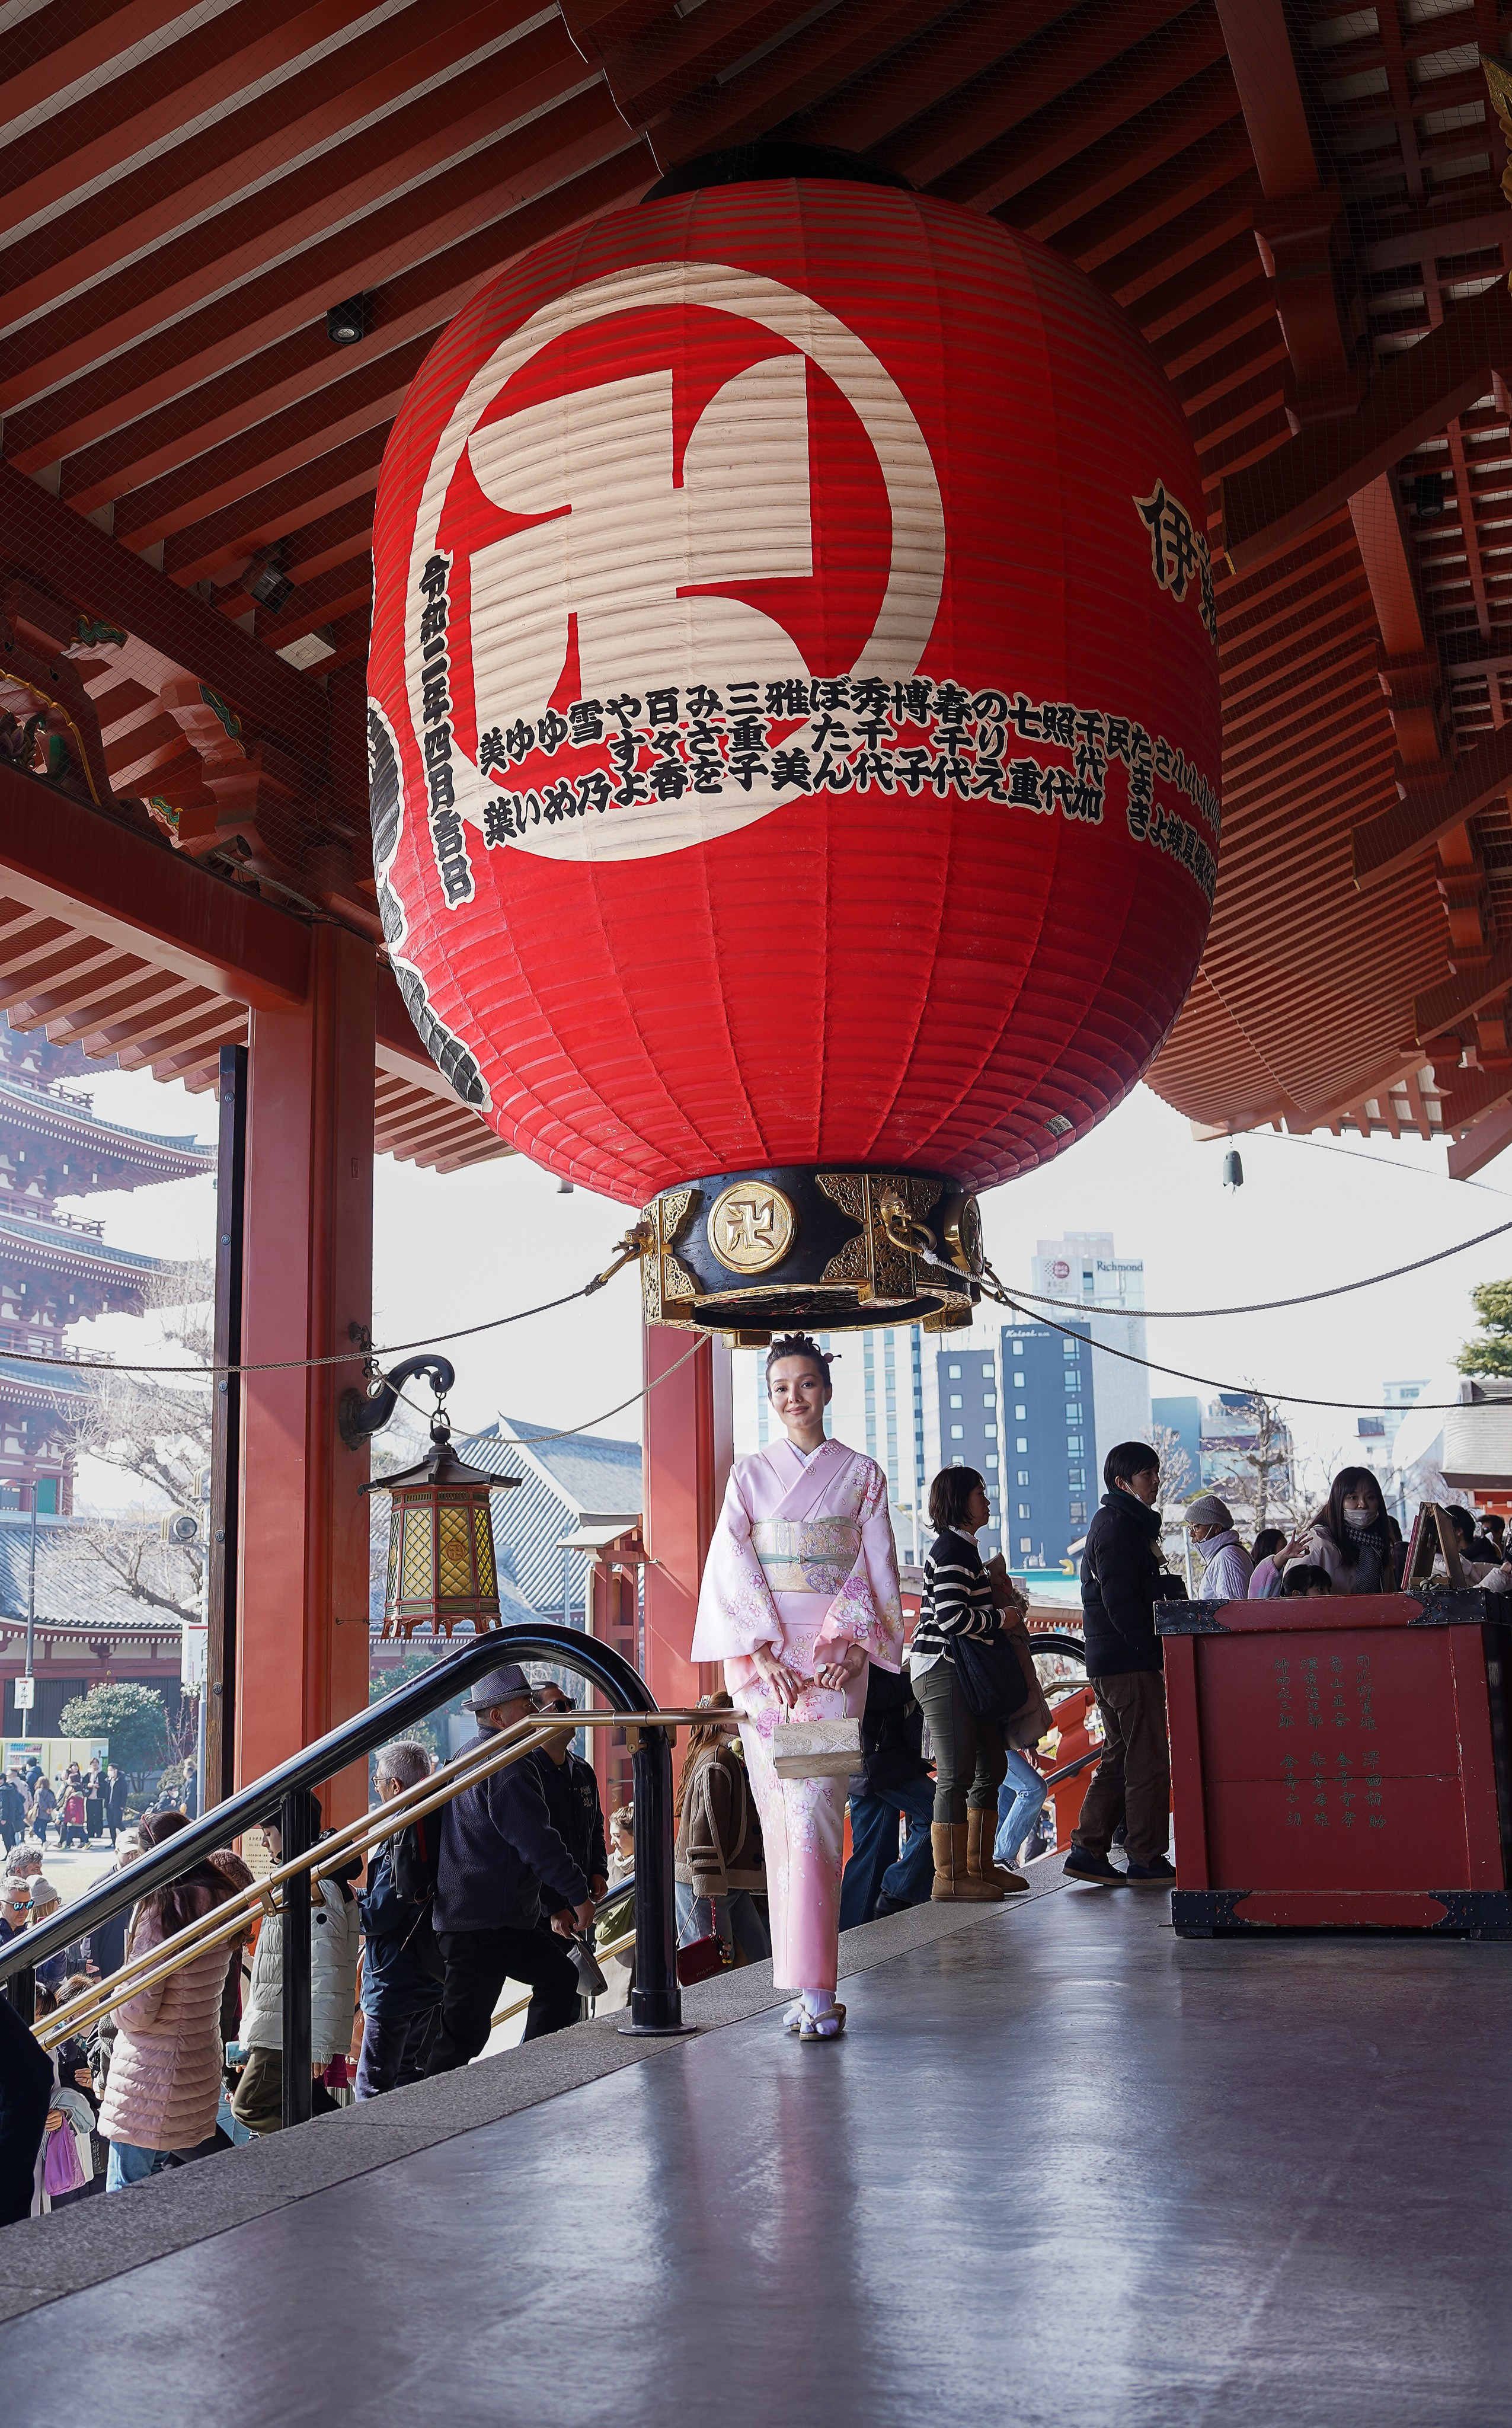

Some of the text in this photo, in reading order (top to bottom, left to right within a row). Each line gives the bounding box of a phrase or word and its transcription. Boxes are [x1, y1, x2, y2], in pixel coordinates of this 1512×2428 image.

[419, 555, 472, 903] 令和二年四月吉日
[1097, 1260, 1143, 1271] Richmond
